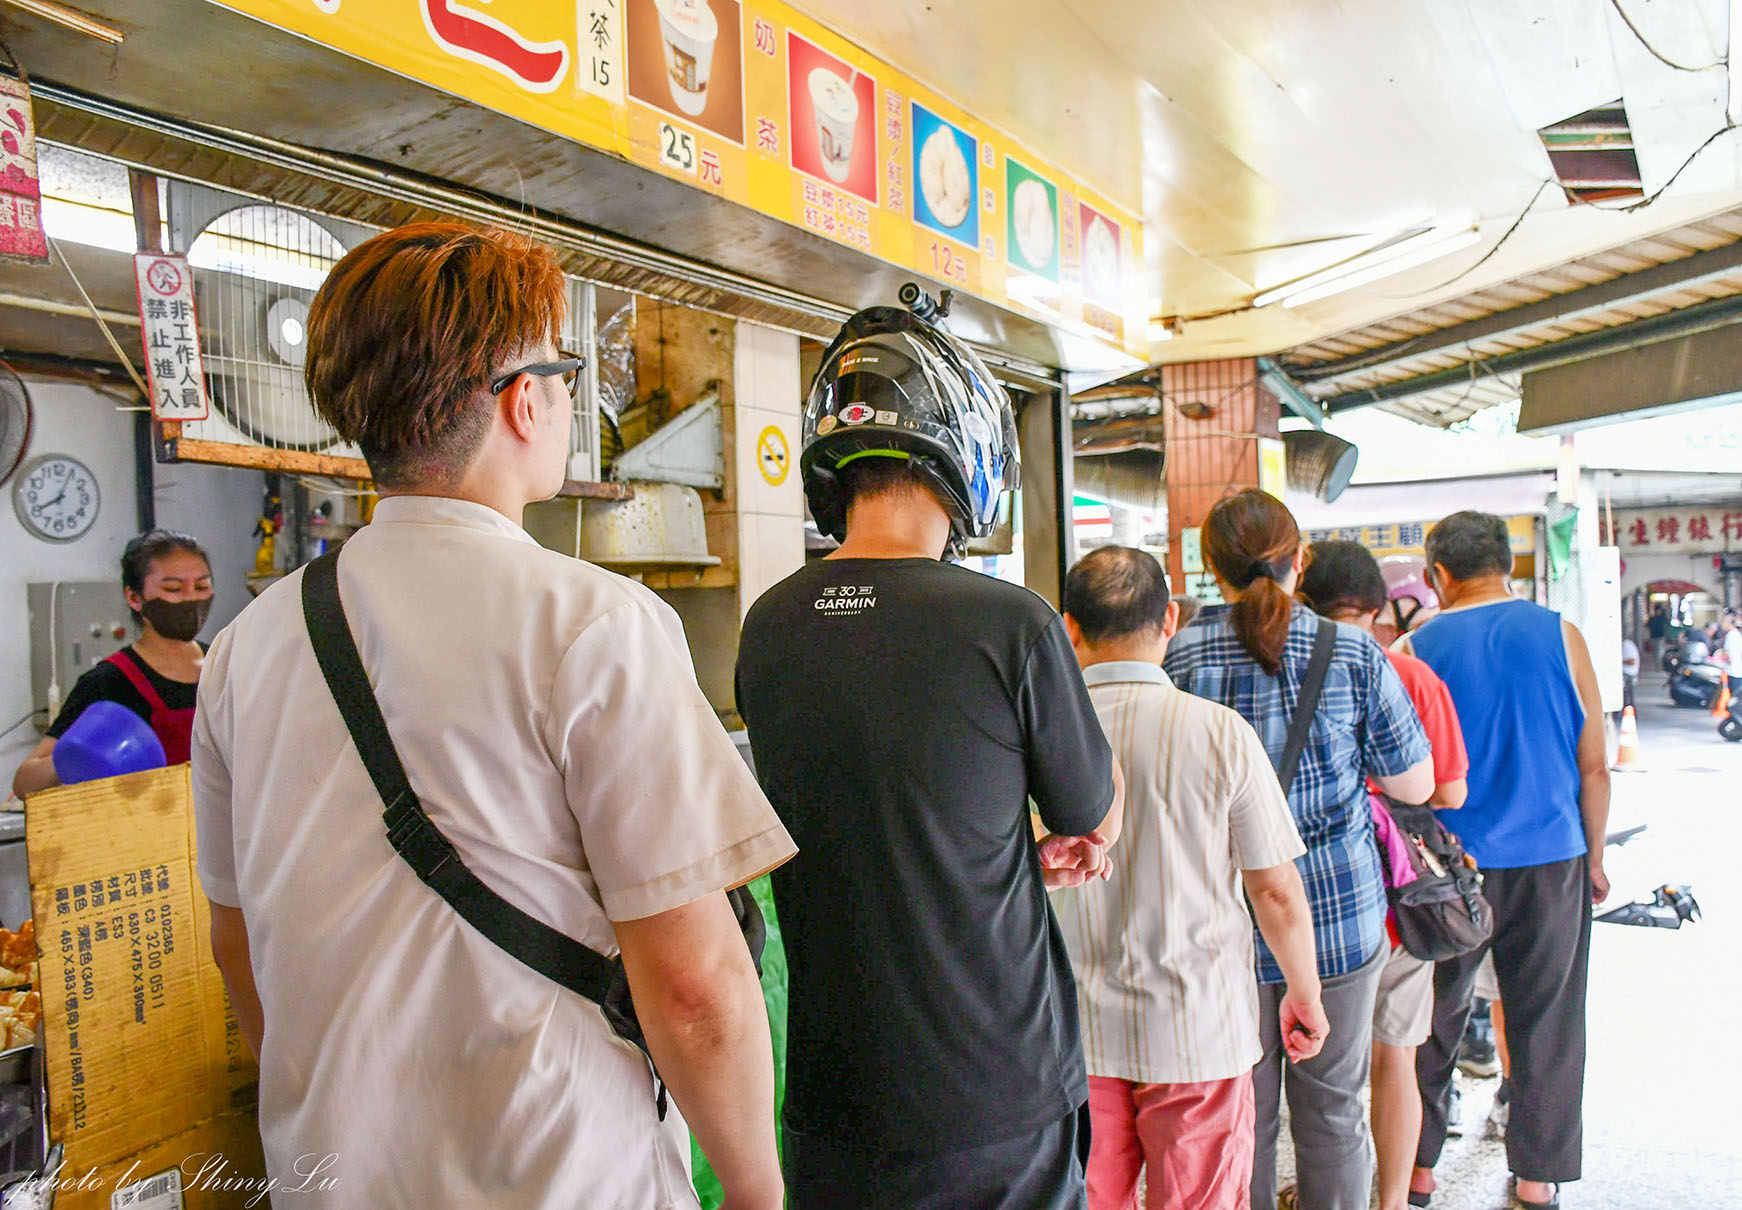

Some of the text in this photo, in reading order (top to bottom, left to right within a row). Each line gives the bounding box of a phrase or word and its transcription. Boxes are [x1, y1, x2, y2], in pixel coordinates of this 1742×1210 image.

[593, 56, 610, 86] 15
[931, 242, 967, 284] 12元
[147, 298, 179, 409] 禁止進入
[170, 299, 201, 409] 非工作人員
[53, 463, 65, 477] 12
[30, 477, 44, 490] 10
[77, 478, 85, 491] 2
[27, 490, 37, 503] 9
[80, 492, 89, 505] 3
[32, 505, 42, 518] 8
[43, 516, 52, 529] 7
[54, 519, 64, 532] 6
[840, 586, 856, 597] 30
[814, 597, 877, 610] GARMIN
